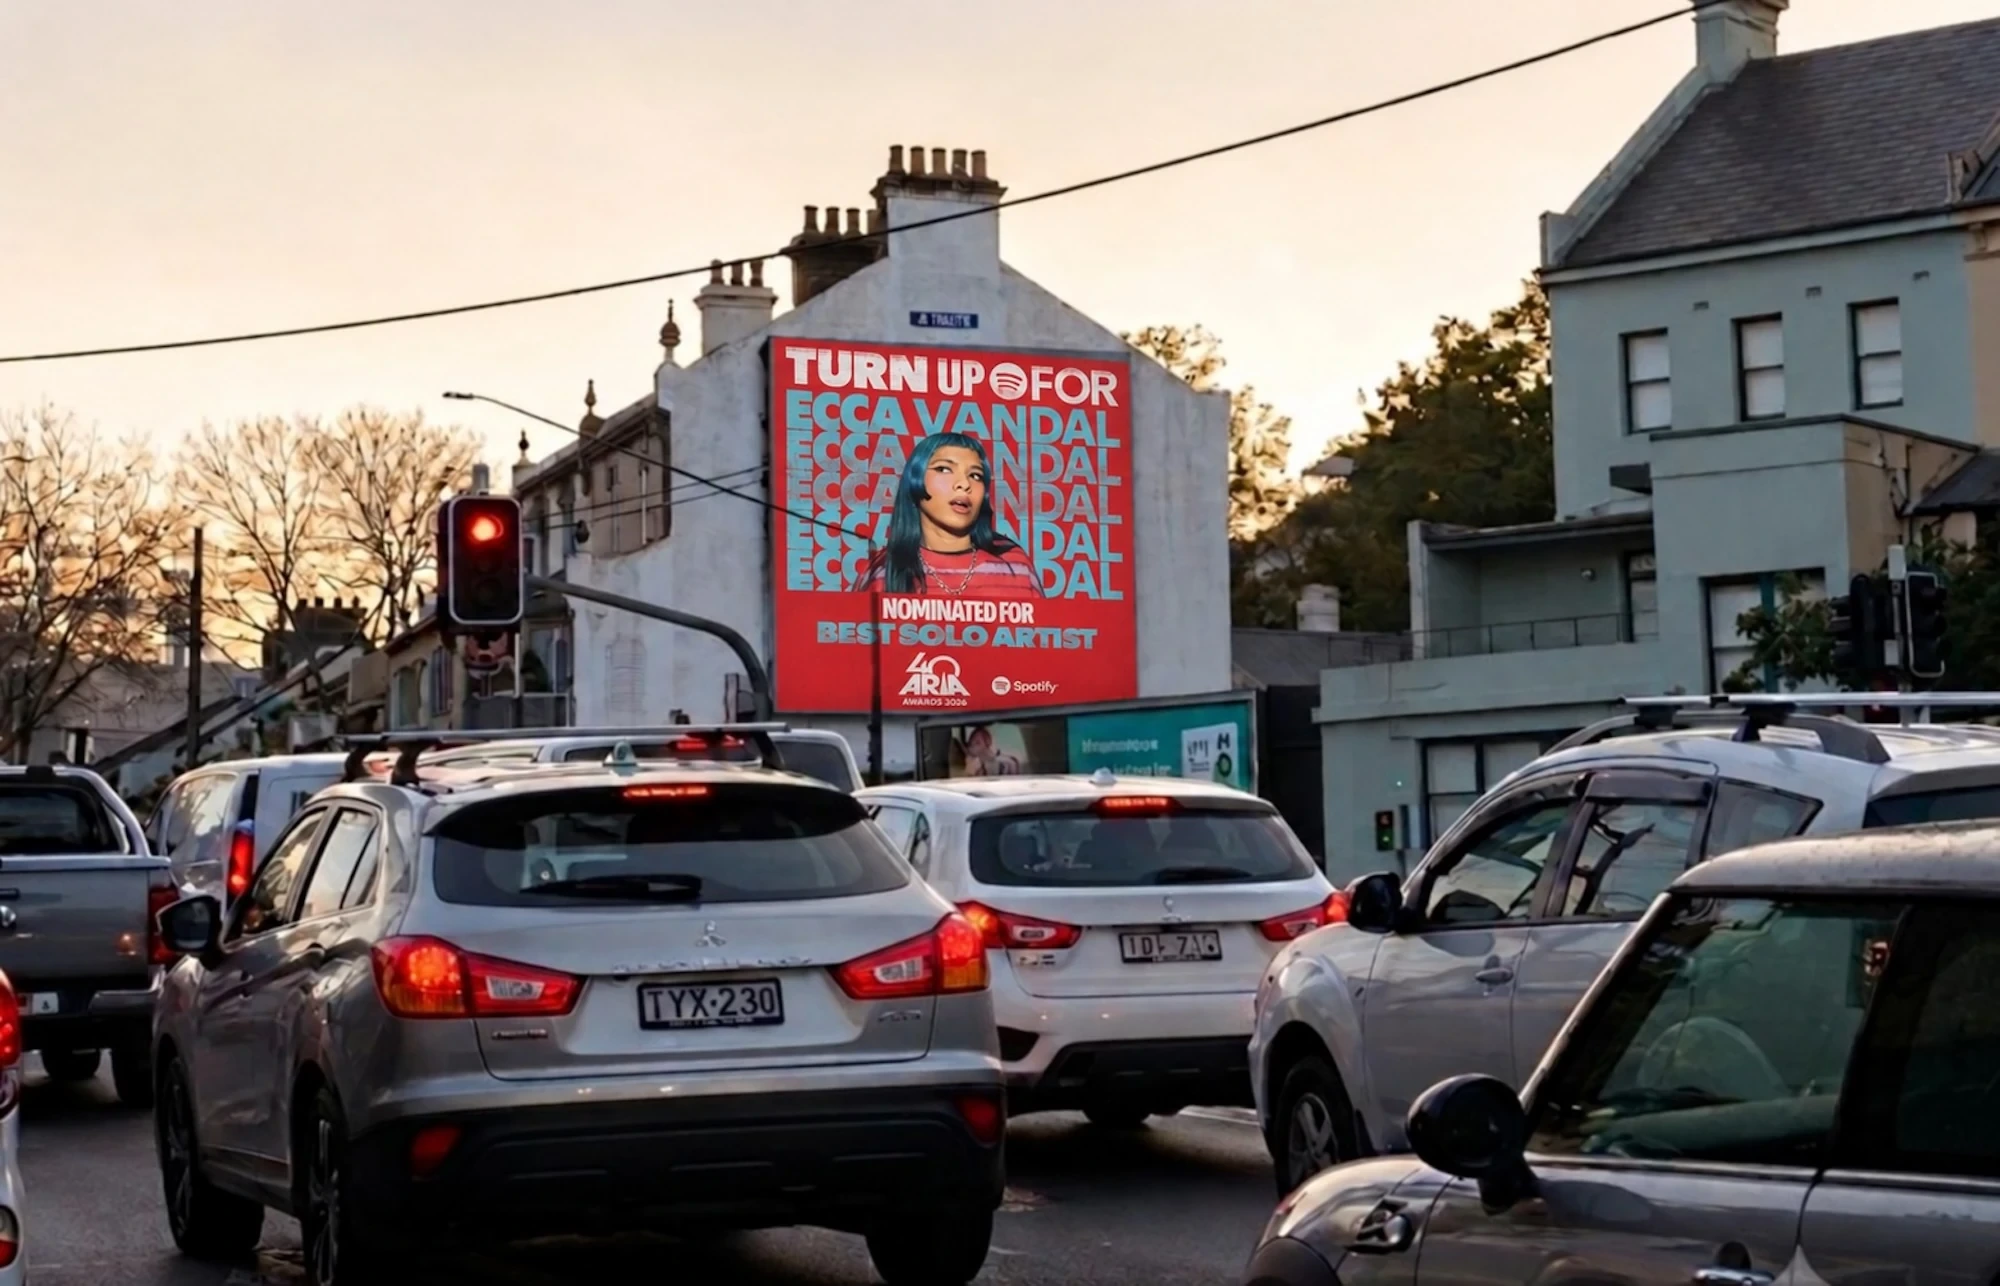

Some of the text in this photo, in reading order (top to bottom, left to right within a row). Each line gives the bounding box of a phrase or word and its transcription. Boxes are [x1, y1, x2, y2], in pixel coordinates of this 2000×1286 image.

[785, 346, 1119, 407] TURN UP FOR
[786, 389, 1121, 448] ECCA VANDAL
[786, 428, 1121, 486] ECCA NDAL
[994, 480, 1122, 524] NDAL
[995, 518, 1123, 562] NDAL
[787, 549, 869, 592] ECC
[882, 598, 1034, 624] NOMINATED FOR
[817, 621, 1098, 649] BEST SOLO ARTIST
[899, 671, 970, 697] ARIA
[1013, 681, 1057, 694] Spotify
